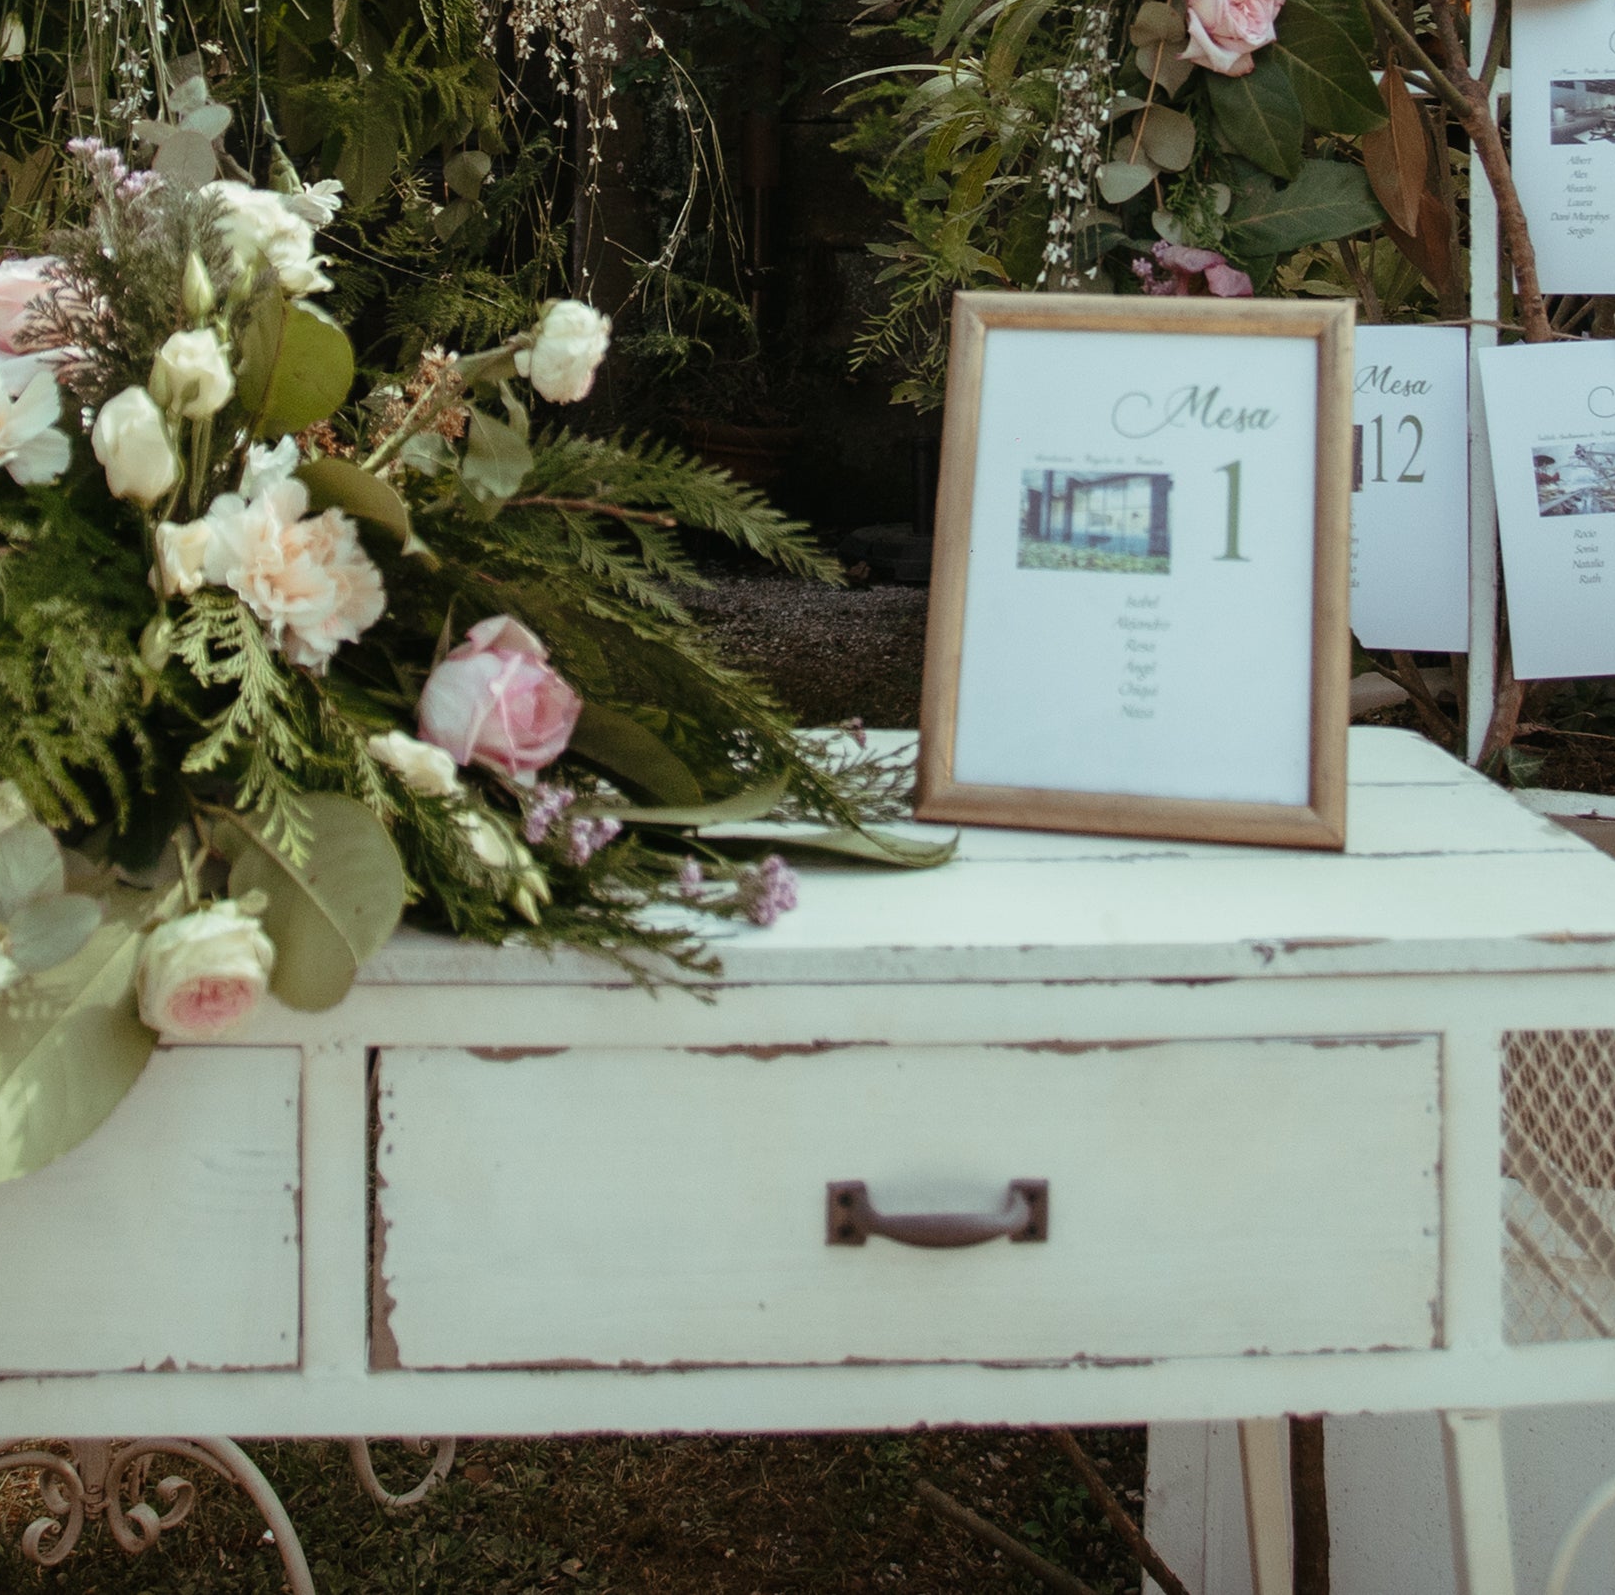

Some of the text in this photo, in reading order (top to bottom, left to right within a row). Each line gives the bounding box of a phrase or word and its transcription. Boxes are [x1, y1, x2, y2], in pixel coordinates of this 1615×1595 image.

[1354, 365, 1433, 397] Mesa
[1111, 385, 1280, 438] Mesa
[1371, 414, 1426, 483] 12
[1213, 460, 1251, 562] 1
[1573, 559, 1606, 569] Natalia
[1579, 574, 1602, 584] Ruth
